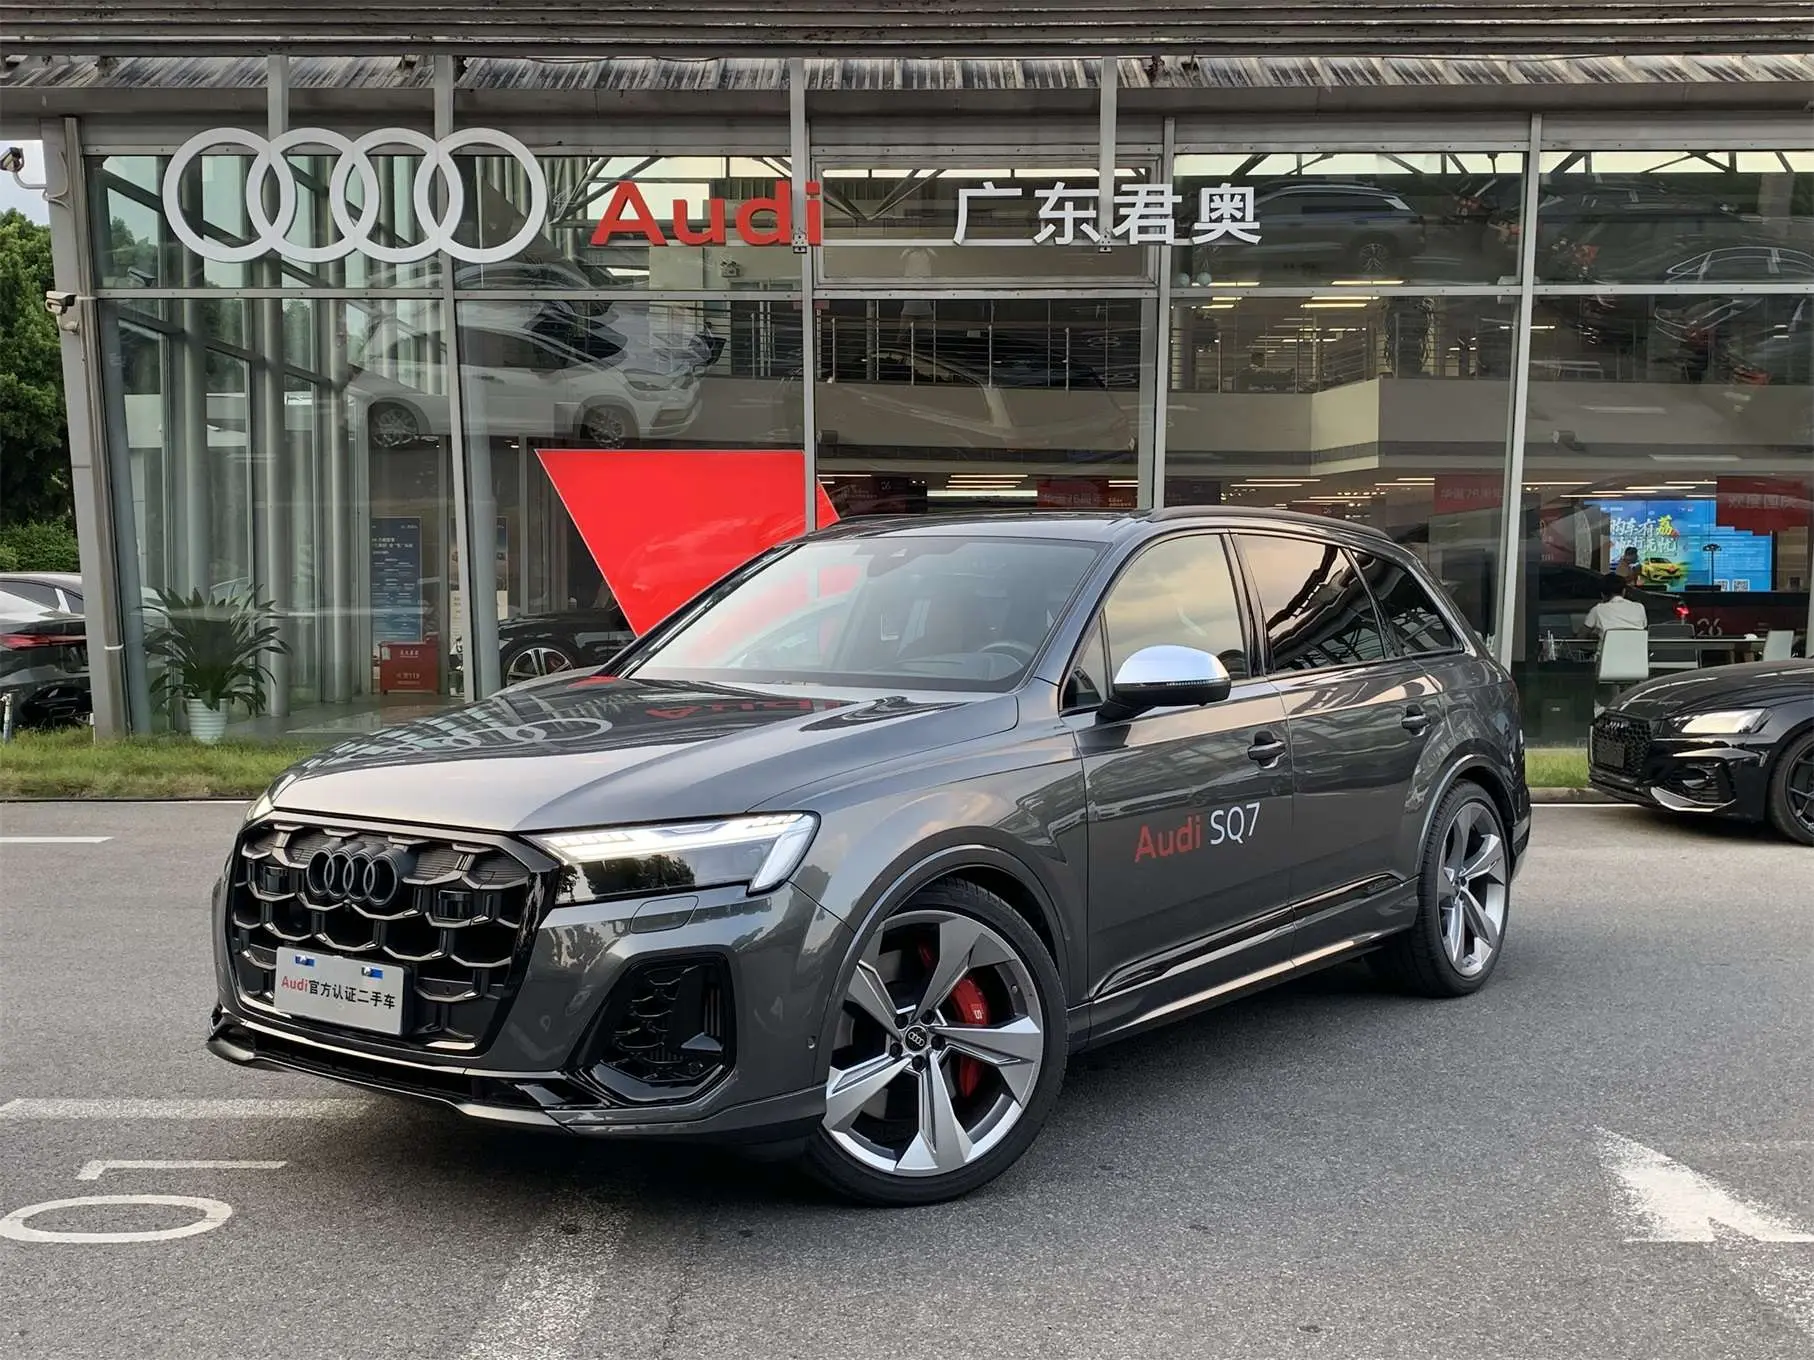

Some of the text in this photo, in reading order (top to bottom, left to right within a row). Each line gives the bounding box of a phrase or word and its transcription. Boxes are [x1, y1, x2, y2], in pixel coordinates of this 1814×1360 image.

[590, 180, 821, 246] Audi
[953, 181, 1263, 245] 广东君奥
[1134, 801, 1260, 863] Audi SQ7
